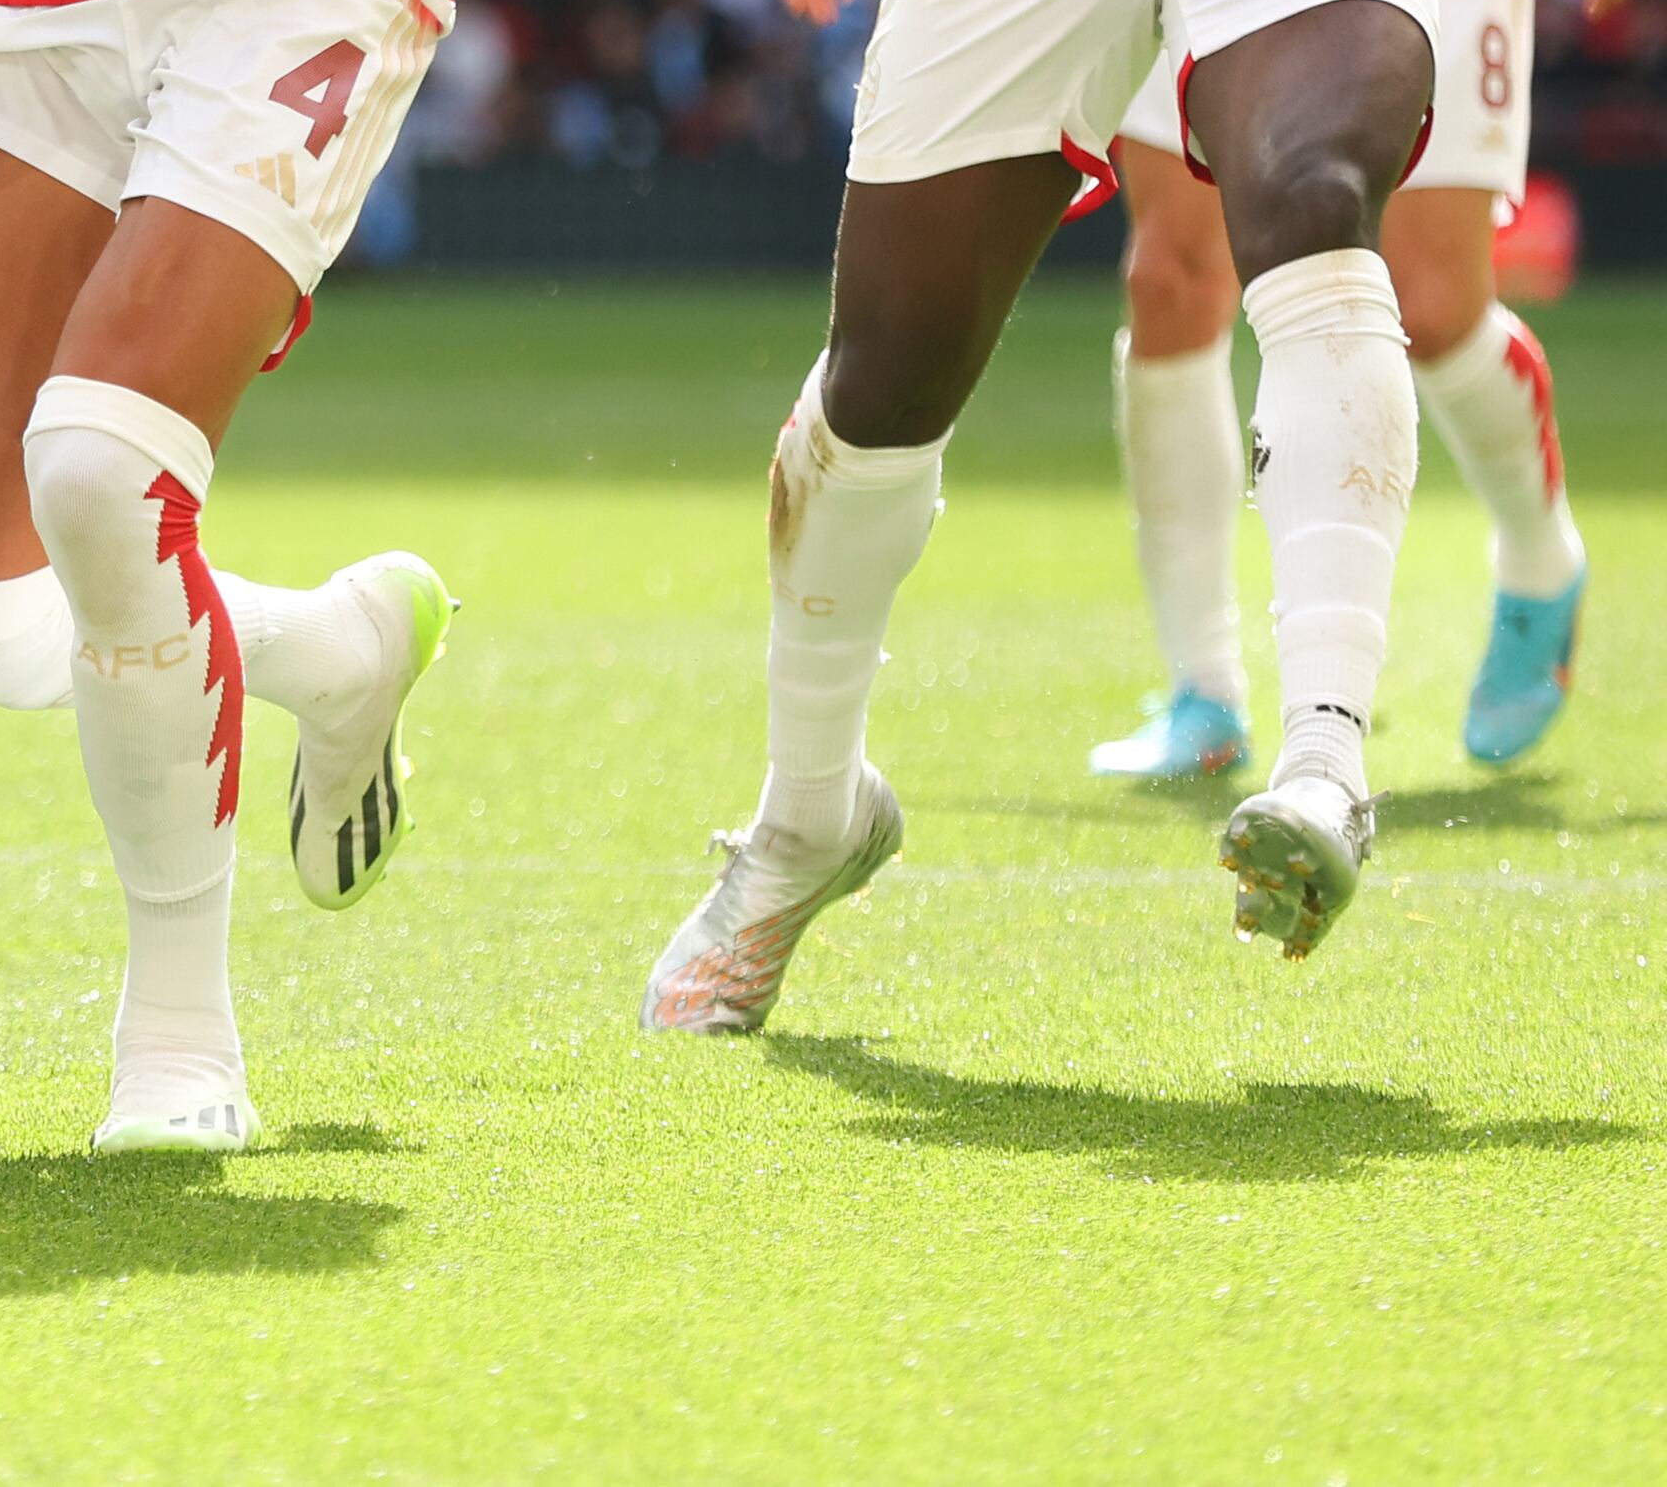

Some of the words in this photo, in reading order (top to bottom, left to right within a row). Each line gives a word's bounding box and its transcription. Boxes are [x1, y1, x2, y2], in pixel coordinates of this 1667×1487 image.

[269, 39, 367, 159] 4
[1479, 22, 1513, 109] 8
[77, 632, 191, 681] AFC
